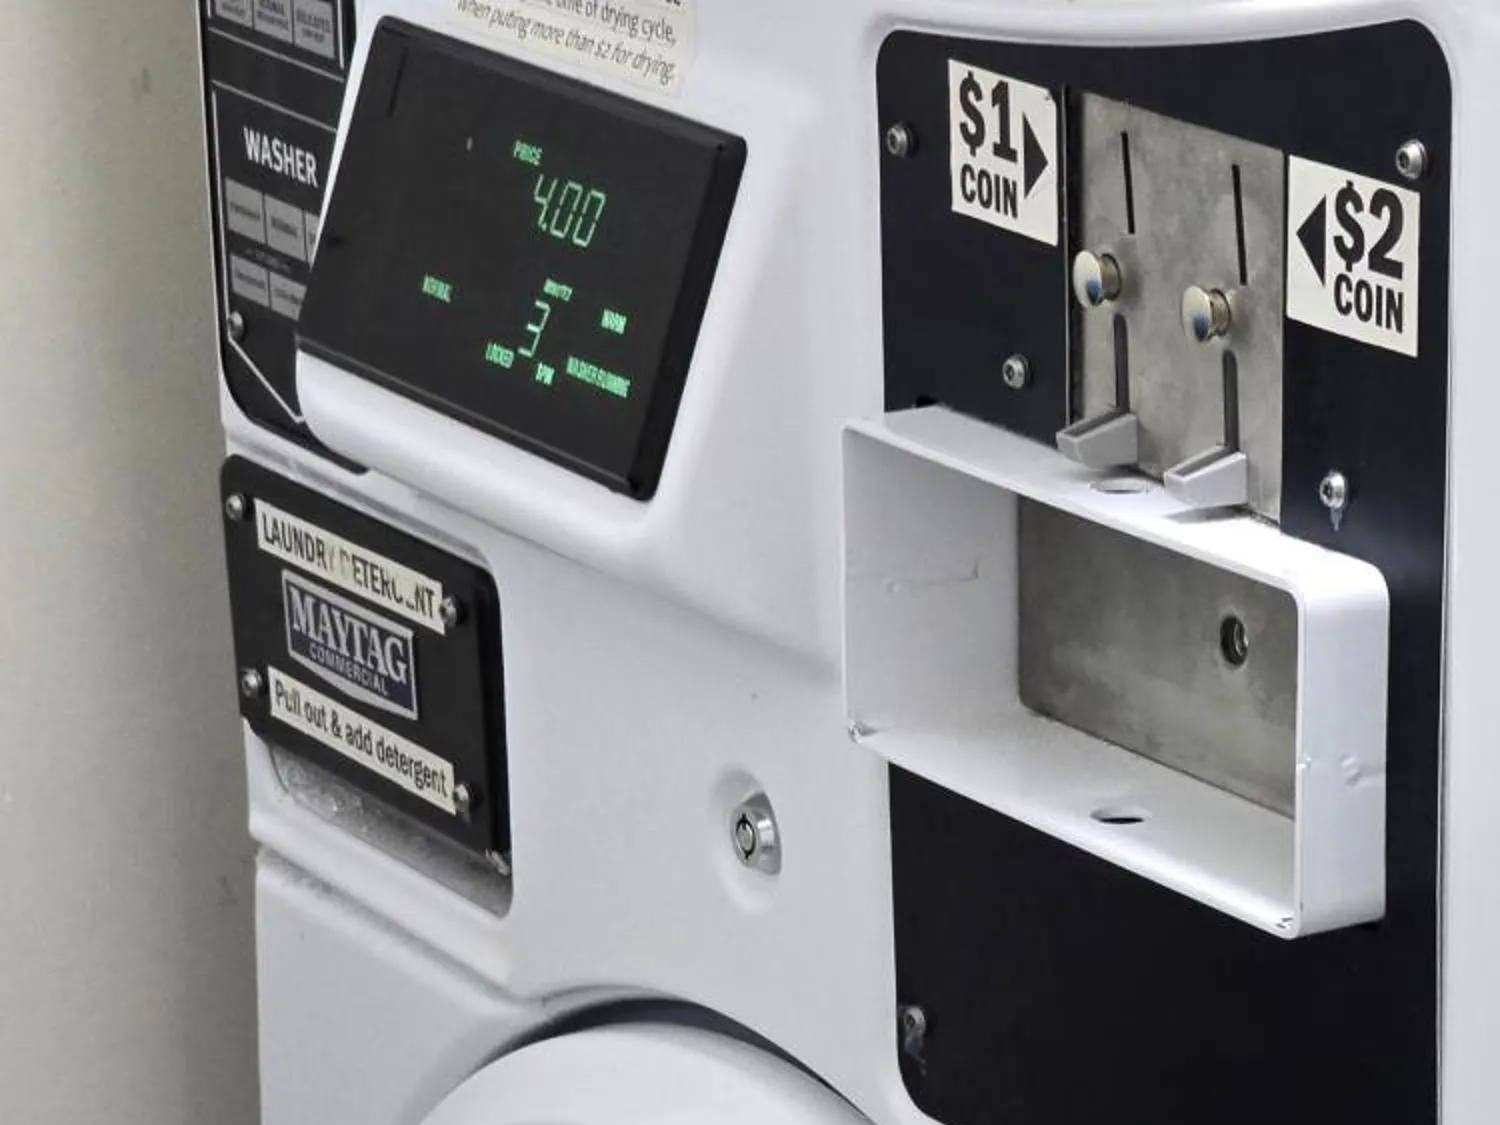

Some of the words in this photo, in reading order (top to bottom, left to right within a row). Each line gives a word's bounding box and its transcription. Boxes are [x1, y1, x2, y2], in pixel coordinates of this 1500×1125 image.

[530, 20, 566, 44] more
[565, 29, 595, 53] than
[601, 4, 639, 38] drying
[642, 18, 677, 47] cycle,
[958, 70, 1017, 163] $1
[243, 125, 318, 188] WASHER
[534, 174, 606, 247] 4.00
[960, 163, 1019, 219] COIN
[1332, 179, 1404, 280] $2
[518, 300, 550, 357] 3
[1334, 272, 1404, 334] COIN
[290, 585, 407, 684] MAYTAG
[309, 642, 388, 697] COMMERCIAL
[275, 678, 300, 713] Pull
[304, 700, 328, 732] out
[331, 710, 342, 738] &
[345, 724, 373, 754] add
[376, 736, 448, 797] detergent
